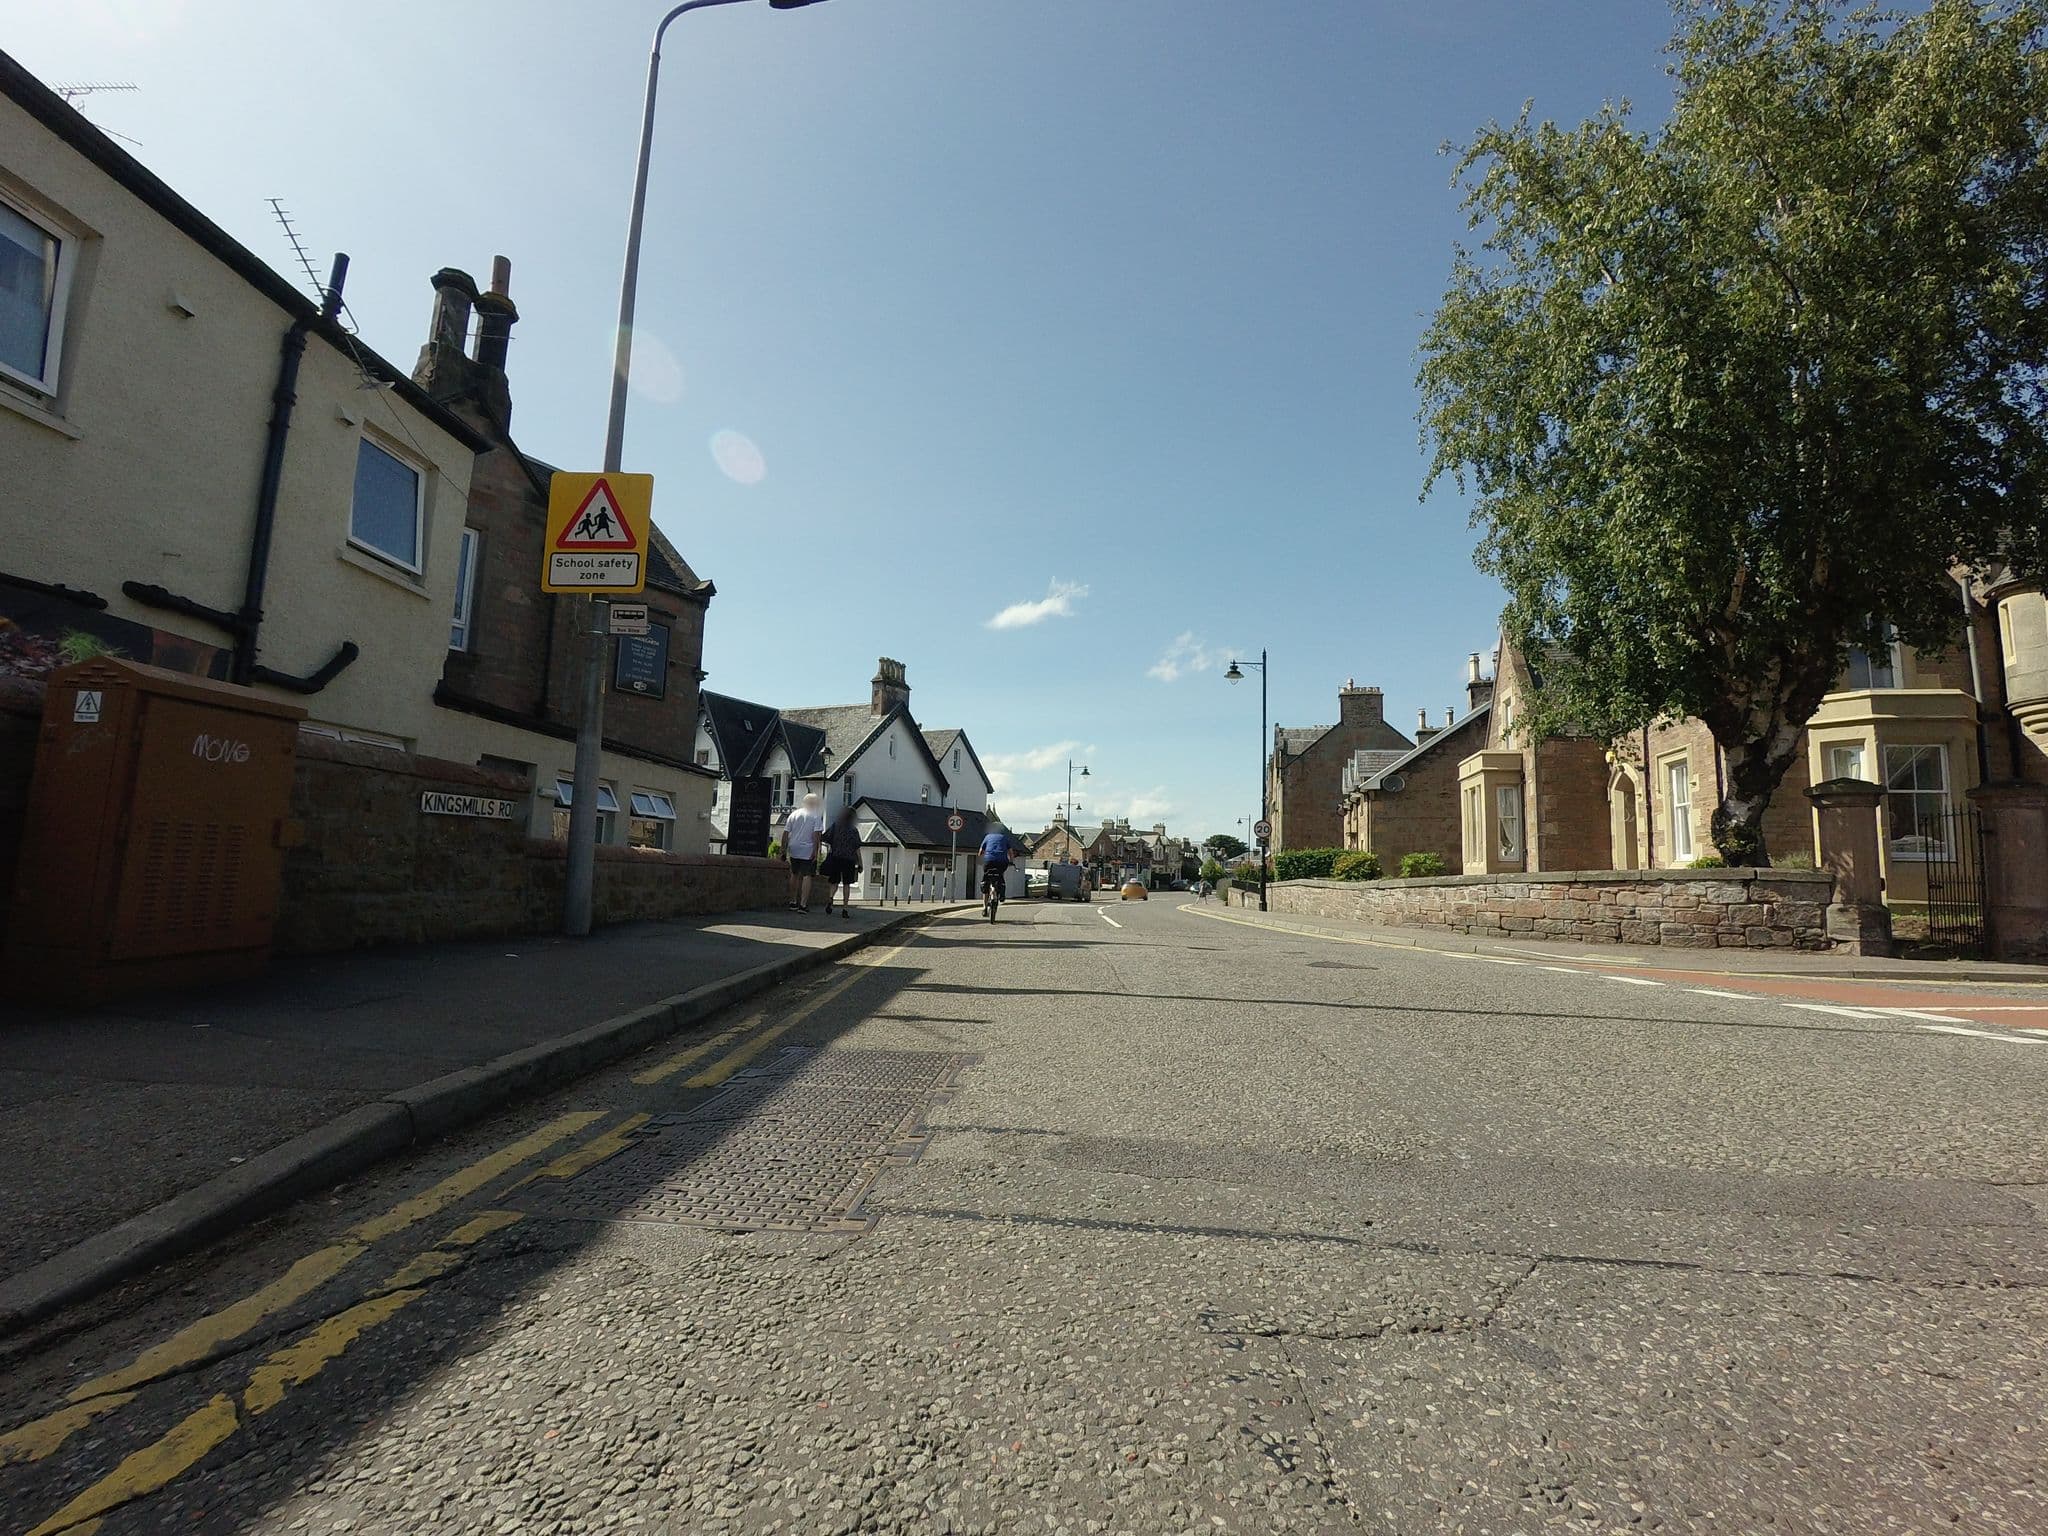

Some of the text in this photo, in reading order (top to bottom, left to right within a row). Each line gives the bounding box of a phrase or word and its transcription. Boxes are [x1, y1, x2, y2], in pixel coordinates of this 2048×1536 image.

[555, 558, 633, 570] School safety
[579, 572, 606, 580] zone
[424, 794, 494, 816] KINGSMILLS
[950, 819, 962, 827] 20
[1257, 825, 1270, 833] 20
